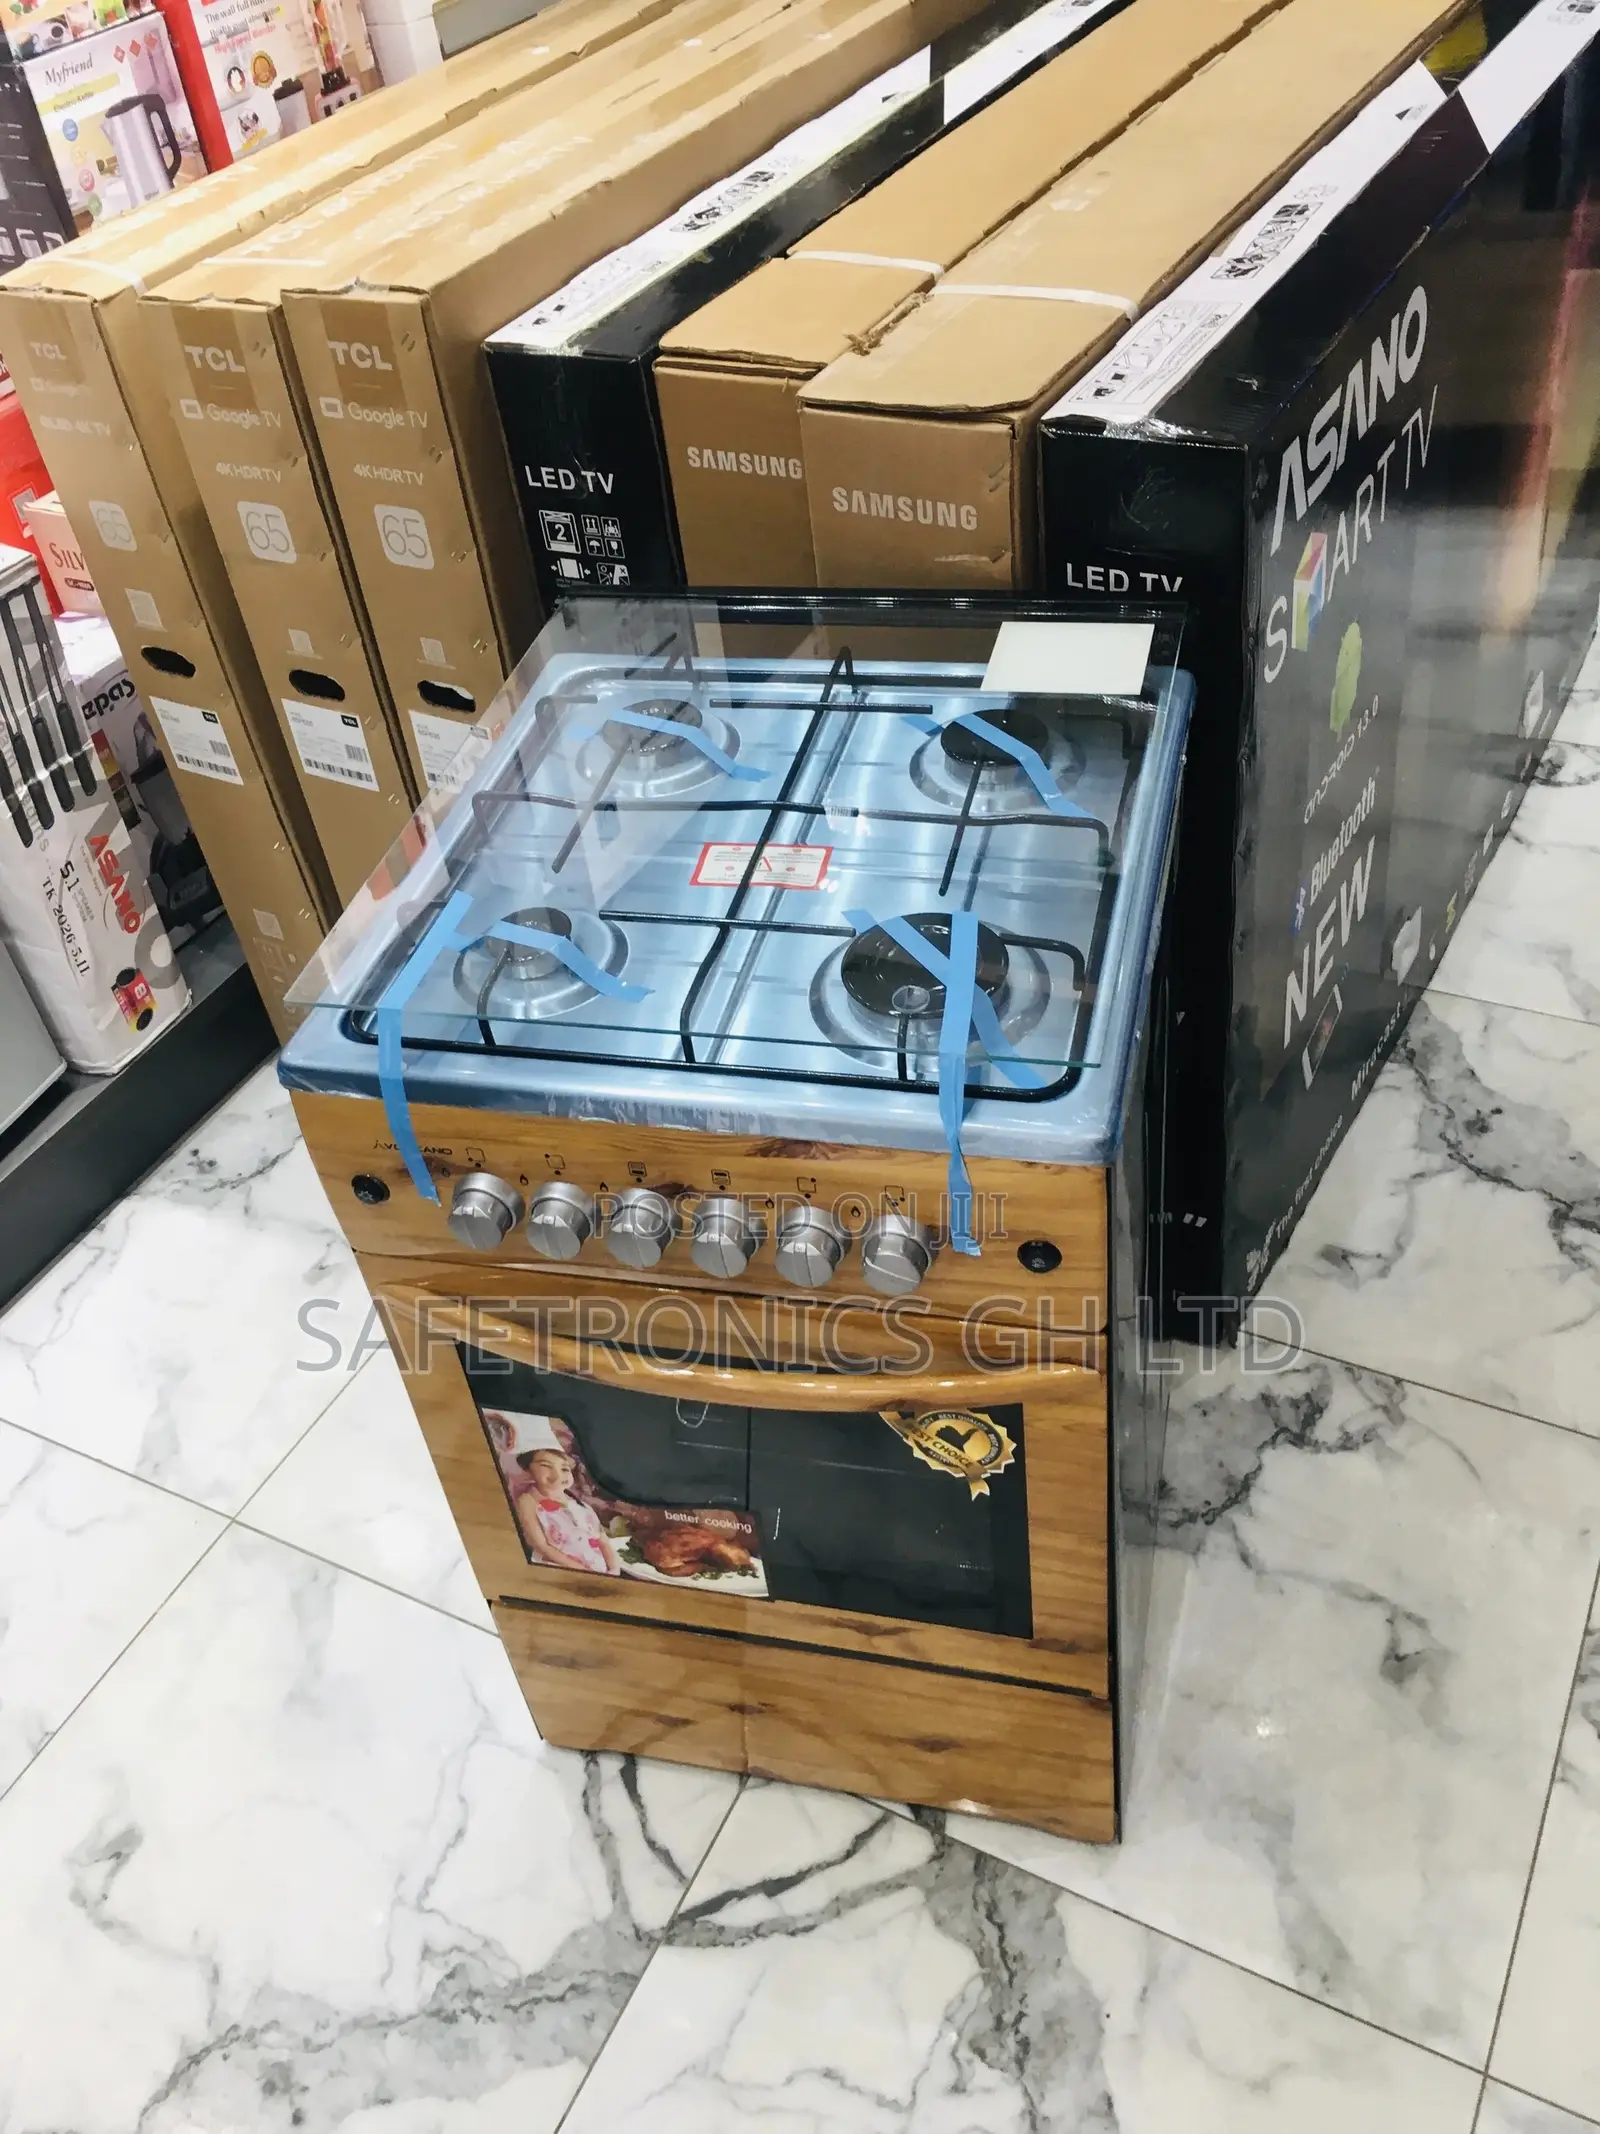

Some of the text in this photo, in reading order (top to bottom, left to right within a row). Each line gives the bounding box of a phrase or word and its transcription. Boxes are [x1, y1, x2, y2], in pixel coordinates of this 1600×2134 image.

[45, 52, 93, 86] Myfriend
[29, 341, 67, 360] TCL
[184, 345, 246, 373] TCL
[327, 341, 393, 371] TCL
[206, 403, 282, 429] Google TV
[348, 402, 428, 429] Google TV
[1269, 285, 1428, 557] ASANO
[1402, 384, 1438, 489] TV
[687, 446, 802, 479] SAMSUNG
[525, 465, 614, 494] LED TV
[832, 486, 978, 530] SAMSUNG
[246, 510, 290, 554] 65
[382, 514, 428, 558] 65
[554, 523, 567, 541] 2
[1066, 562, 1183, 592] LED TV
[1310, 776, 1376, 907] Bluetooth
[60, 860, 80, 892] 5.1
[89, 834, 140, 934] ASANO
[42, 877, 58, 902] TK
[53, 905, 76, 944] 2026
[1283, 834, 1375, 1050] NEW
[932, 1438, 974, 1469] CHOICE
[664, 1510, 752, 1534] better cooking
